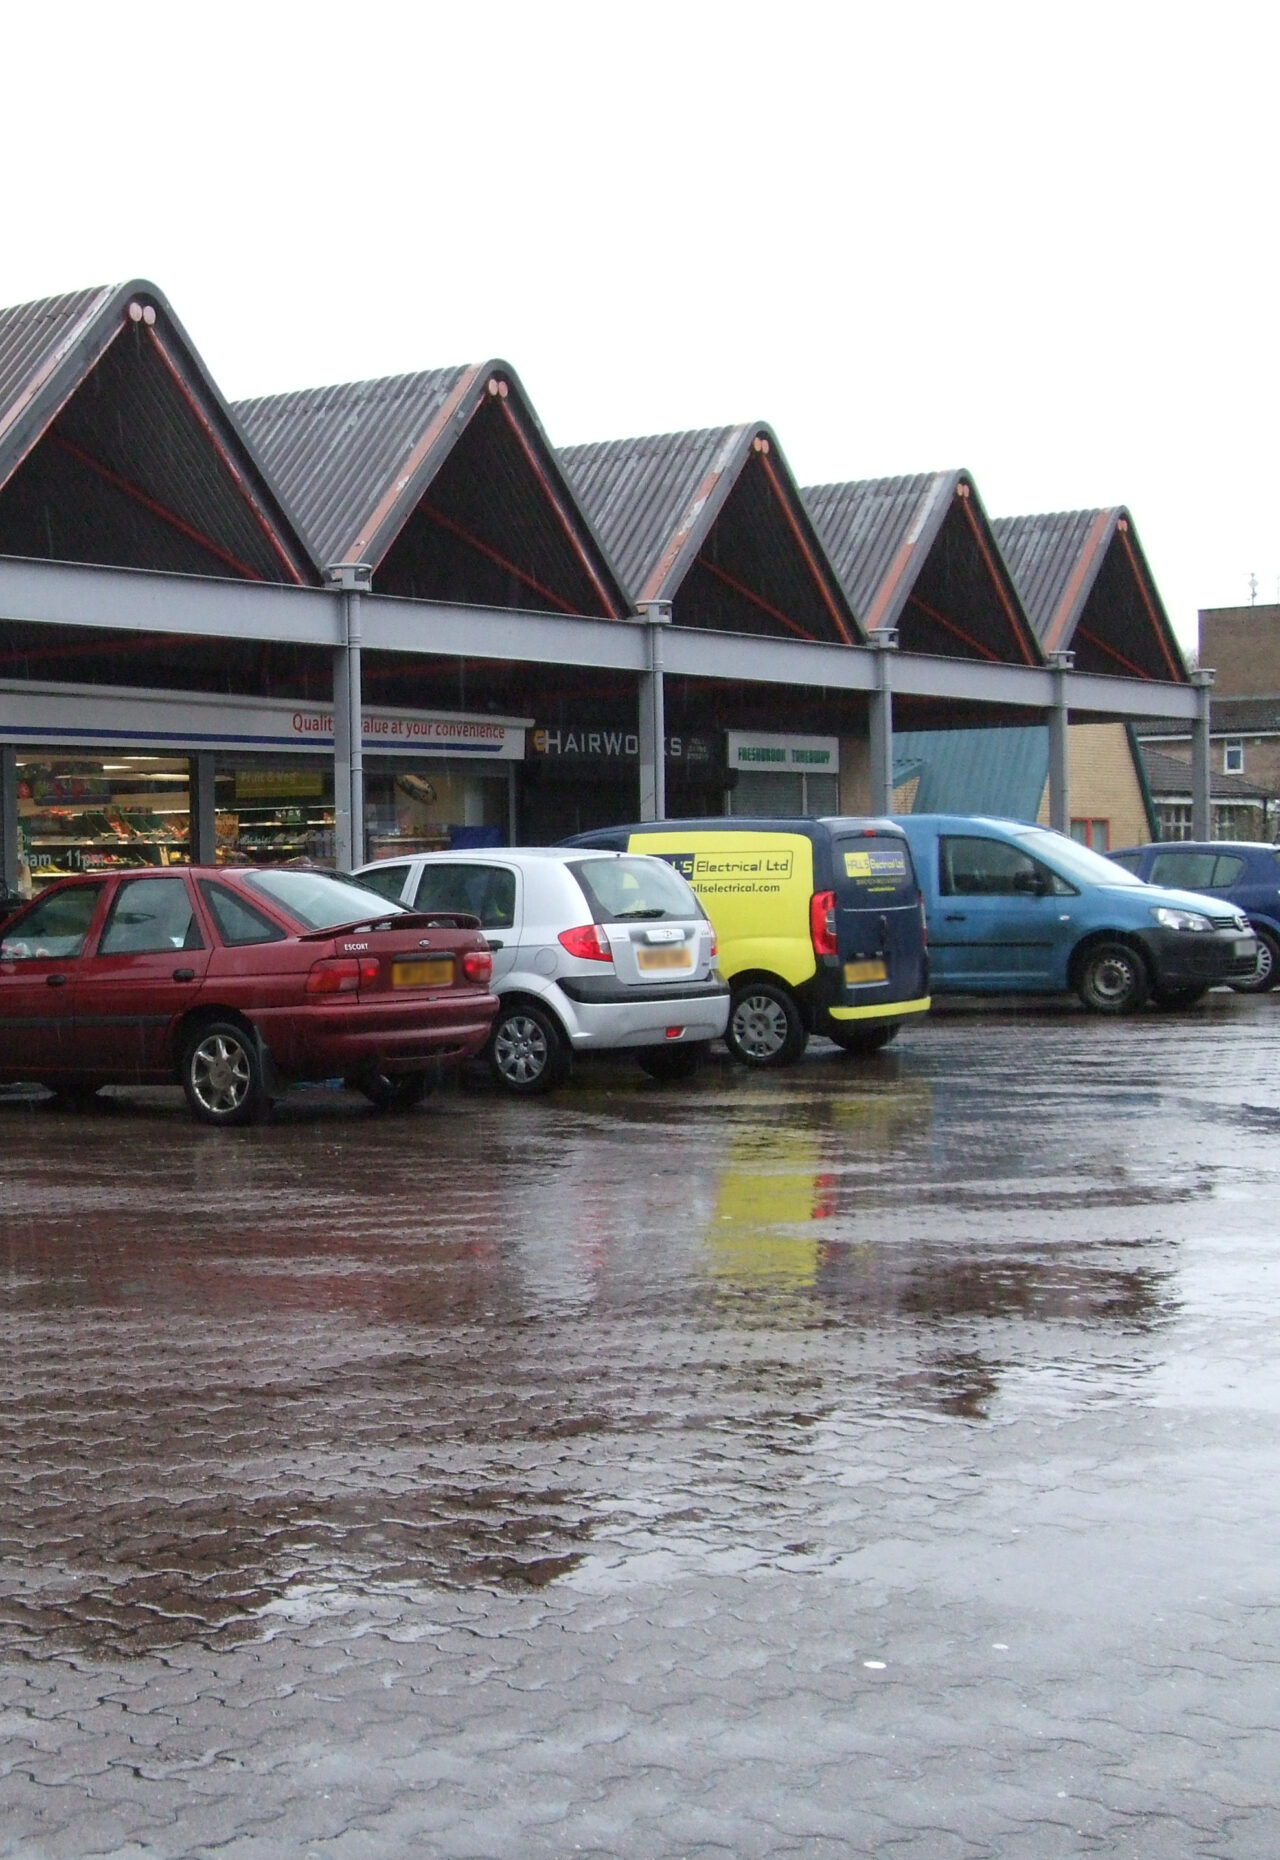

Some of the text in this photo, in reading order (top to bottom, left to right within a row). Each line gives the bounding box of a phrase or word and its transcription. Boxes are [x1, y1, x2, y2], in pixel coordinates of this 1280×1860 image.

[292, 713, 505, 740] Qualit alue at your convenience
[545, 730, 682, 757] HAIRWOS
[696, 860, 762, 872] Electrical
[766, 859, 789, 871] Ltd
[691, 882, 780, 893] allselectrical.com
[344, 943, 369, 951] ESCORT
